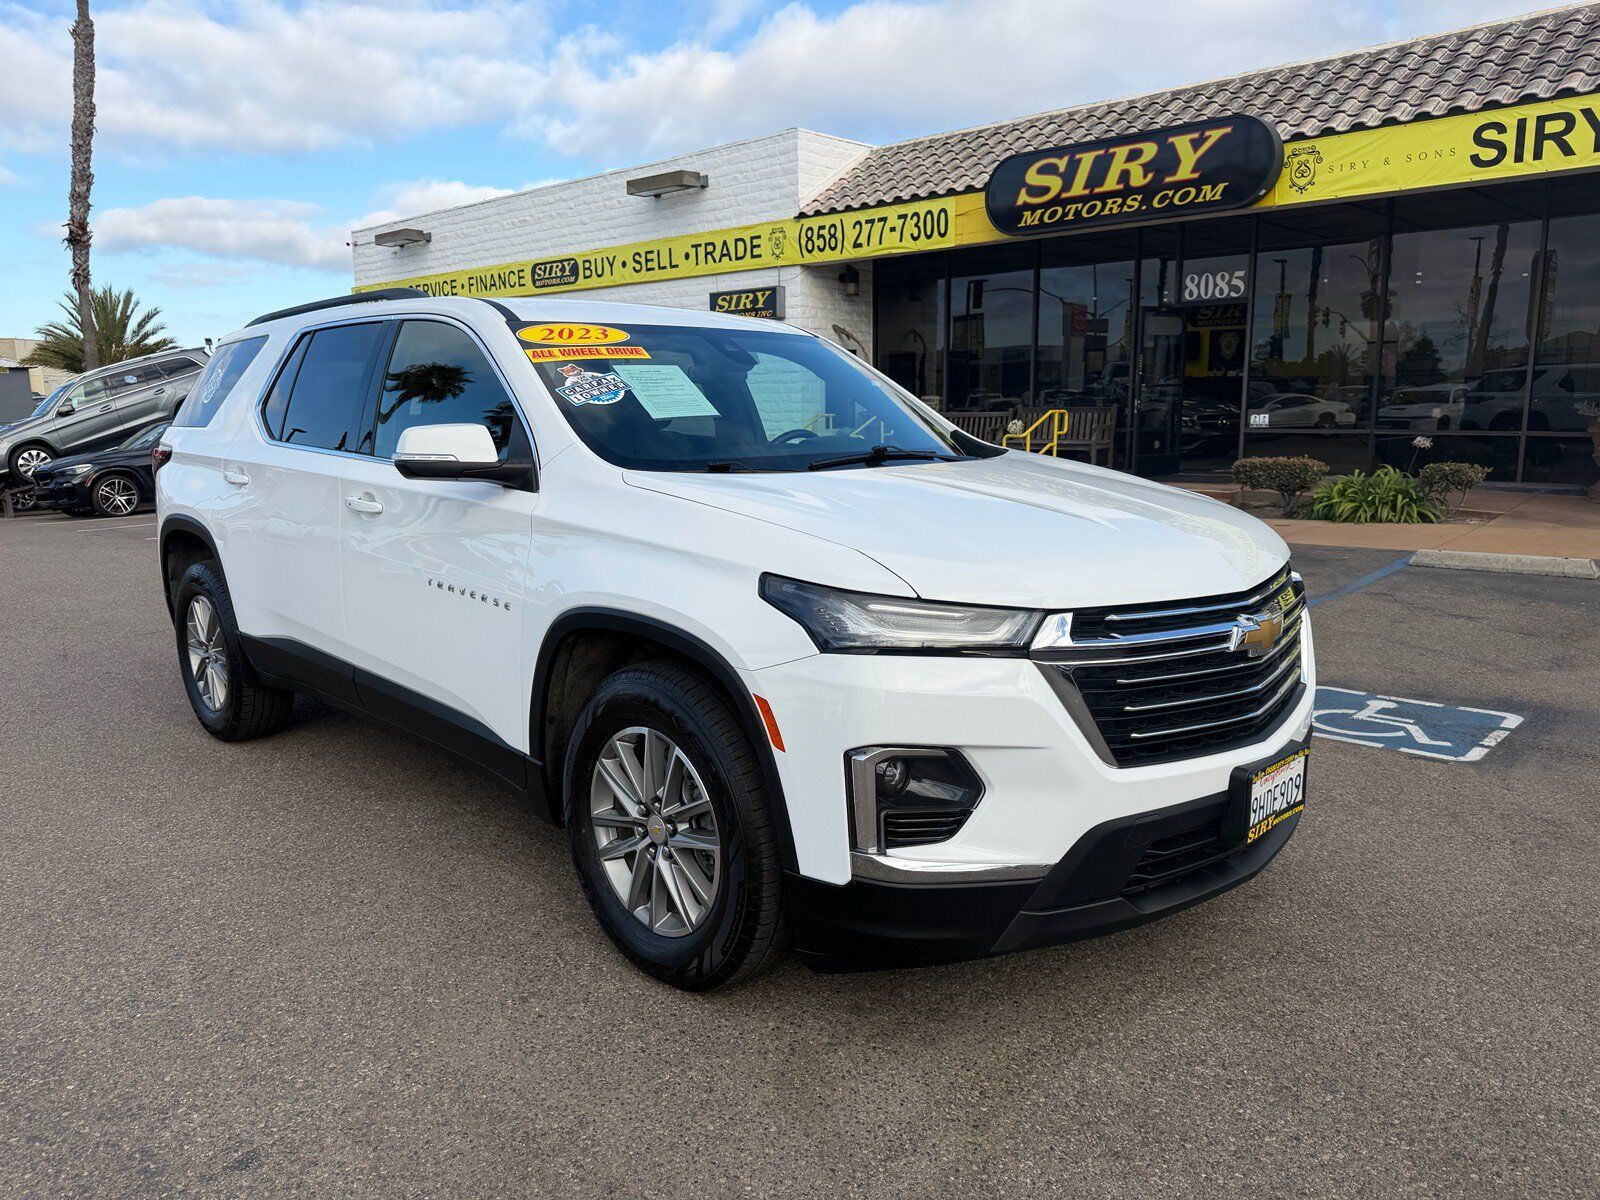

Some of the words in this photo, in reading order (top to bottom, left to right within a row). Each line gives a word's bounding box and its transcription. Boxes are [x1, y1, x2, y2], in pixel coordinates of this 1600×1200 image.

[1015, 126, 1233, 206] SIRY
[1328, 159, 1370, 174] SIRY
[1383, 156, 1391, 166] &
[1406, 147, 1456, 163] SONS
[1017, 182, 1229, 227] MOTORS.COM
[799, 219, 845, 257] (858)
[852, 207, 949, 249] 277-7300
[534, 260, 575, 279] SIRY
[583, 255, 616, 279] BUY
[632, 248, 679, 273] SELL
[691, 235, 762, 265] TRADE
[468, 269, 526, 293] FINANCE
[1184, 271, 1246, 300] 8085
[715, 290, 772, 312] SIRY
[540, 327, 609, 341] 2023
[532, 349, 556, 359] ALL
[560, 347, 605, 357] WHEEL
[605, 346, 643, 356] DRIVE
[563, 376, 619, 395] CARFAX
[582, 382, 627, 399] OWNER
[428, 579, 511, 611] TRAVERSE
[1247, 814, 1276, 844] SIRY
